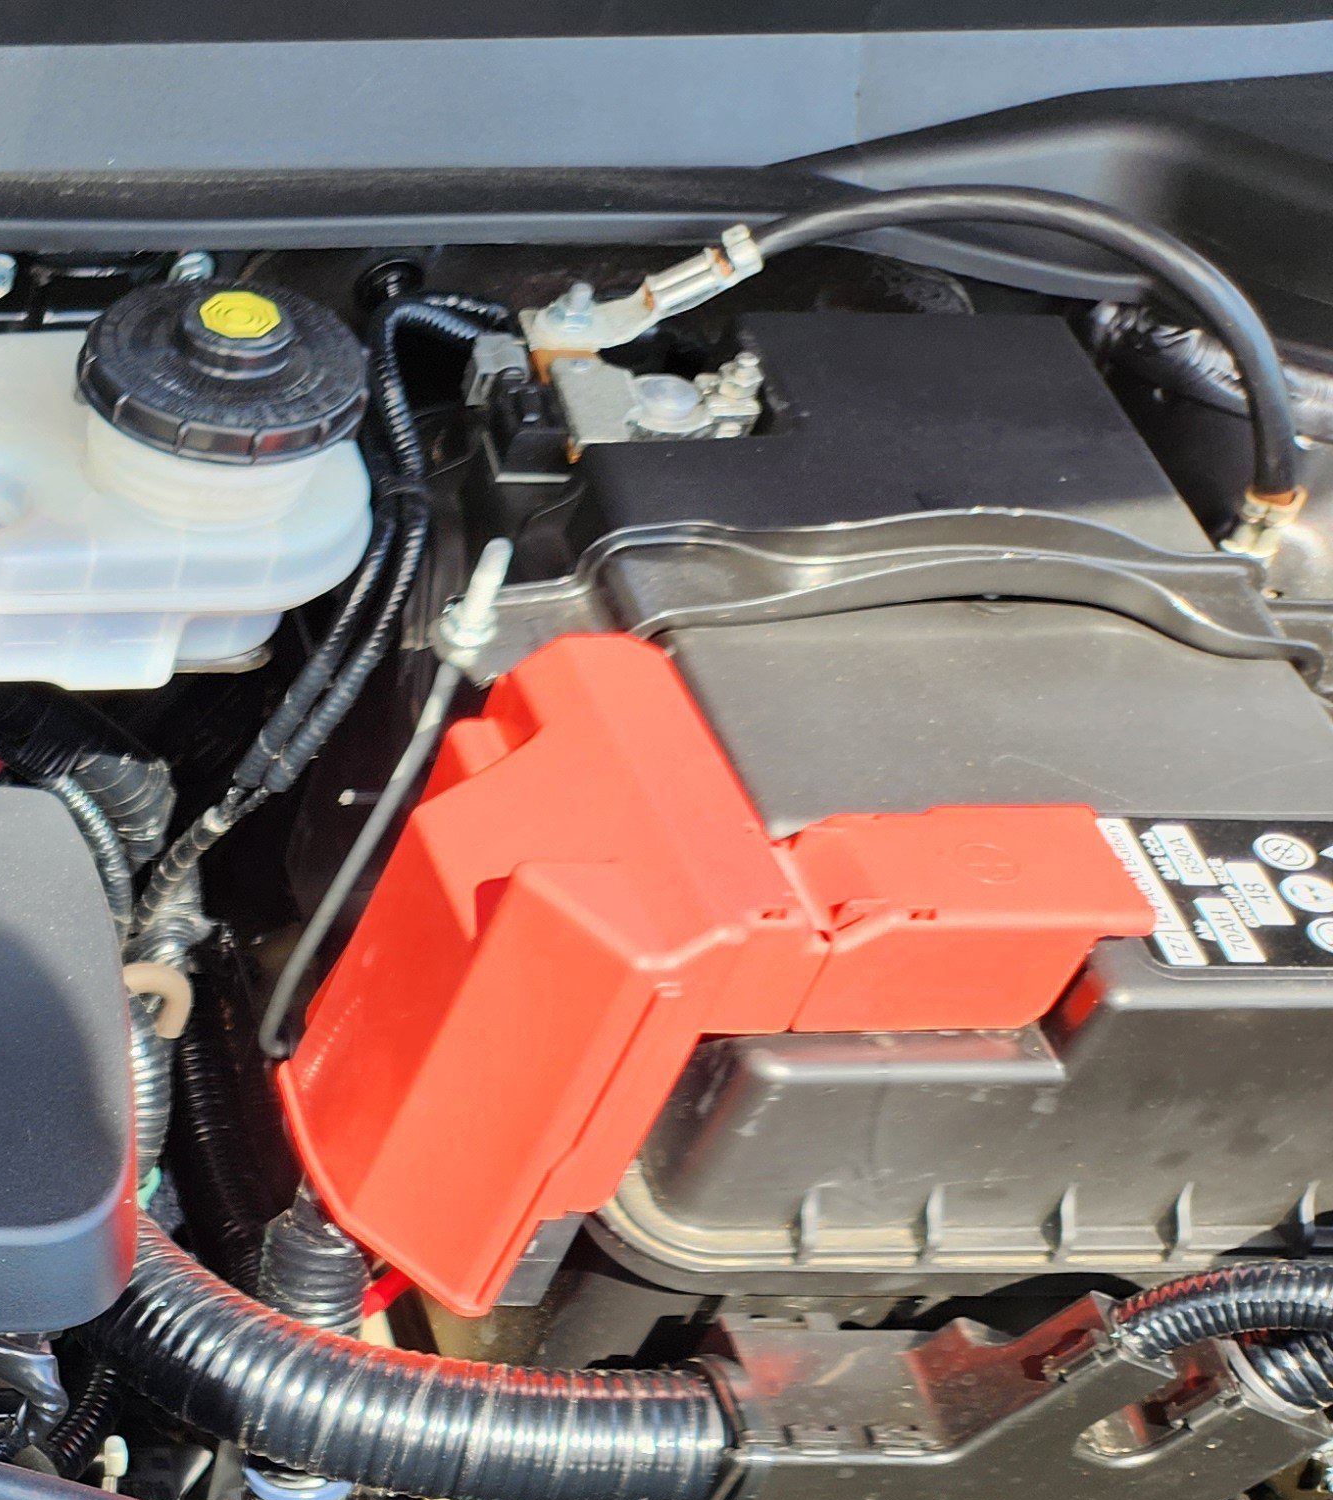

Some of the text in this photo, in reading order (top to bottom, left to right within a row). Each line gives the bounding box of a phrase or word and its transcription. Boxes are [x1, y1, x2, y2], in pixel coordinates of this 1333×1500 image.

[1166, 837, 1202, 876] 650A
[1242, 882, 1271, 906] 48
[1209, 909, 1253, 952] 70AH
